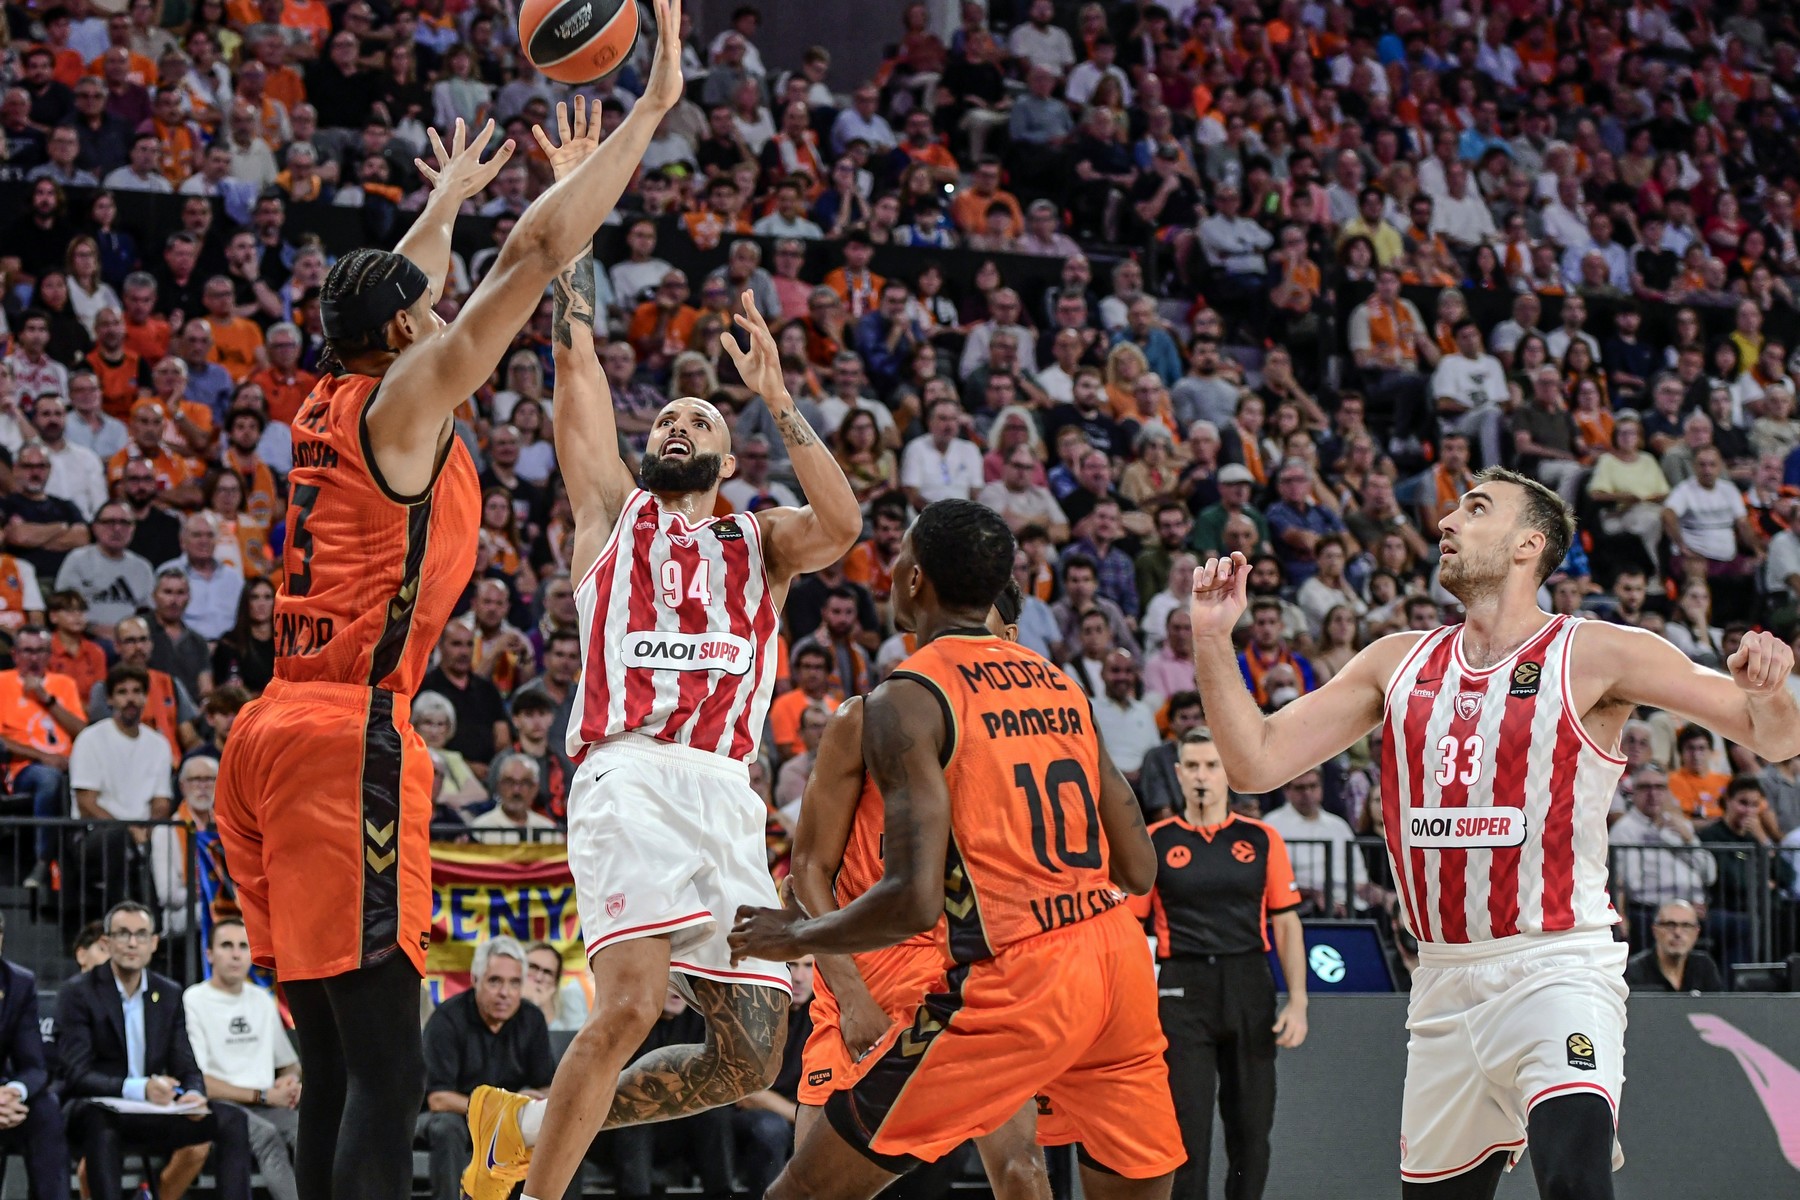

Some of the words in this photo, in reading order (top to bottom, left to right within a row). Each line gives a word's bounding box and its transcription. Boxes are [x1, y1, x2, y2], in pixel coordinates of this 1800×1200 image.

[288, 483, 320, 597] 3
[660, 558, 712, 609] 94
[698, 641, 740, 663] SUPER
[956, 660, 1068, 694] MOORE
[981, 706, 1083, 739] PAMESA
[1434, 734, 1485, 787] 33
[1013, 758, 1103, 874] 10
[1455, 817, 1512, 837] SUPER
[432, 887, 584, 942] PENY
[809, 1072, 830, 1081] PULEVA
[1569, 1060, 1595, 1068] ETIHAD
